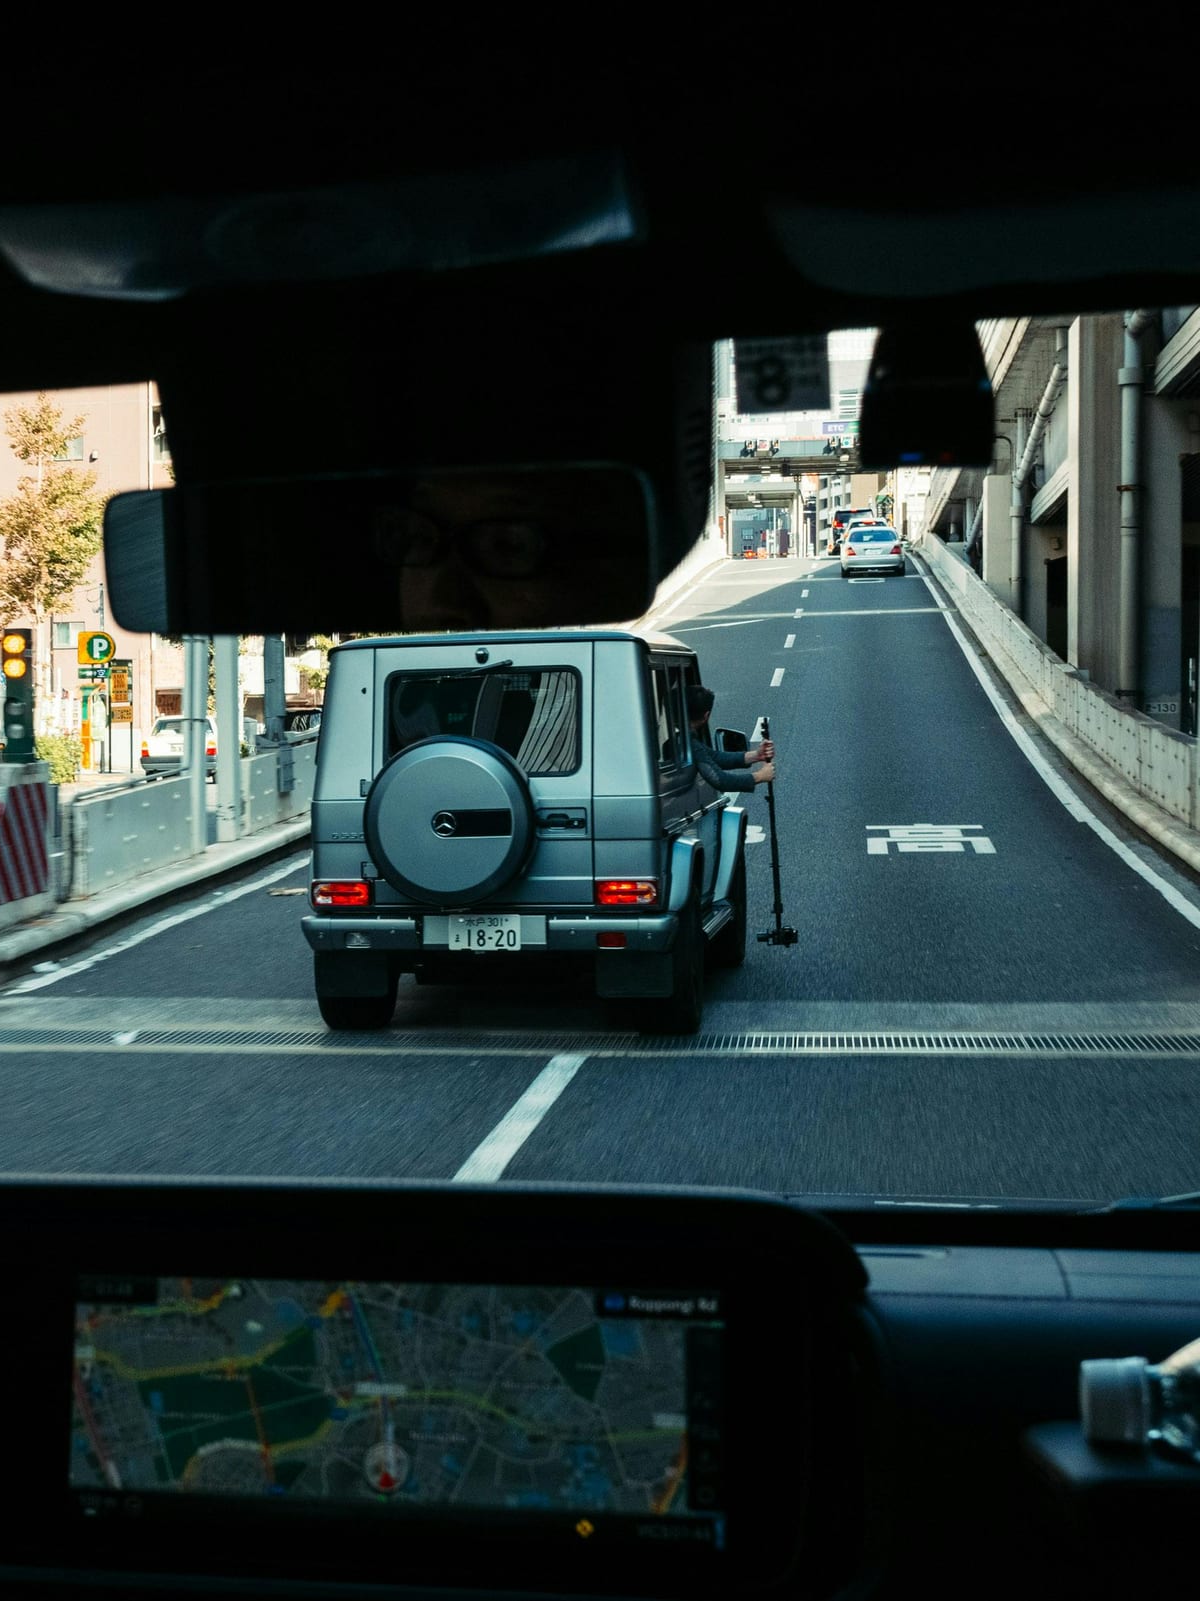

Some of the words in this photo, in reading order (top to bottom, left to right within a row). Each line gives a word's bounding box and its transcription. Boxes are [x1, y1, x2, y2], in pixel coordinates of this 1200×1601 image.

[755, 357, 790, 407] 8
[827, 424, 845, 432] ETC
[92, 638, 108, 659] P
[865, 823, 997, 854] 高
[487, 917, 503, 927] 301
[467, 929, 516, 947] 18-20
[697, 1296, 720, 1313] Rd
